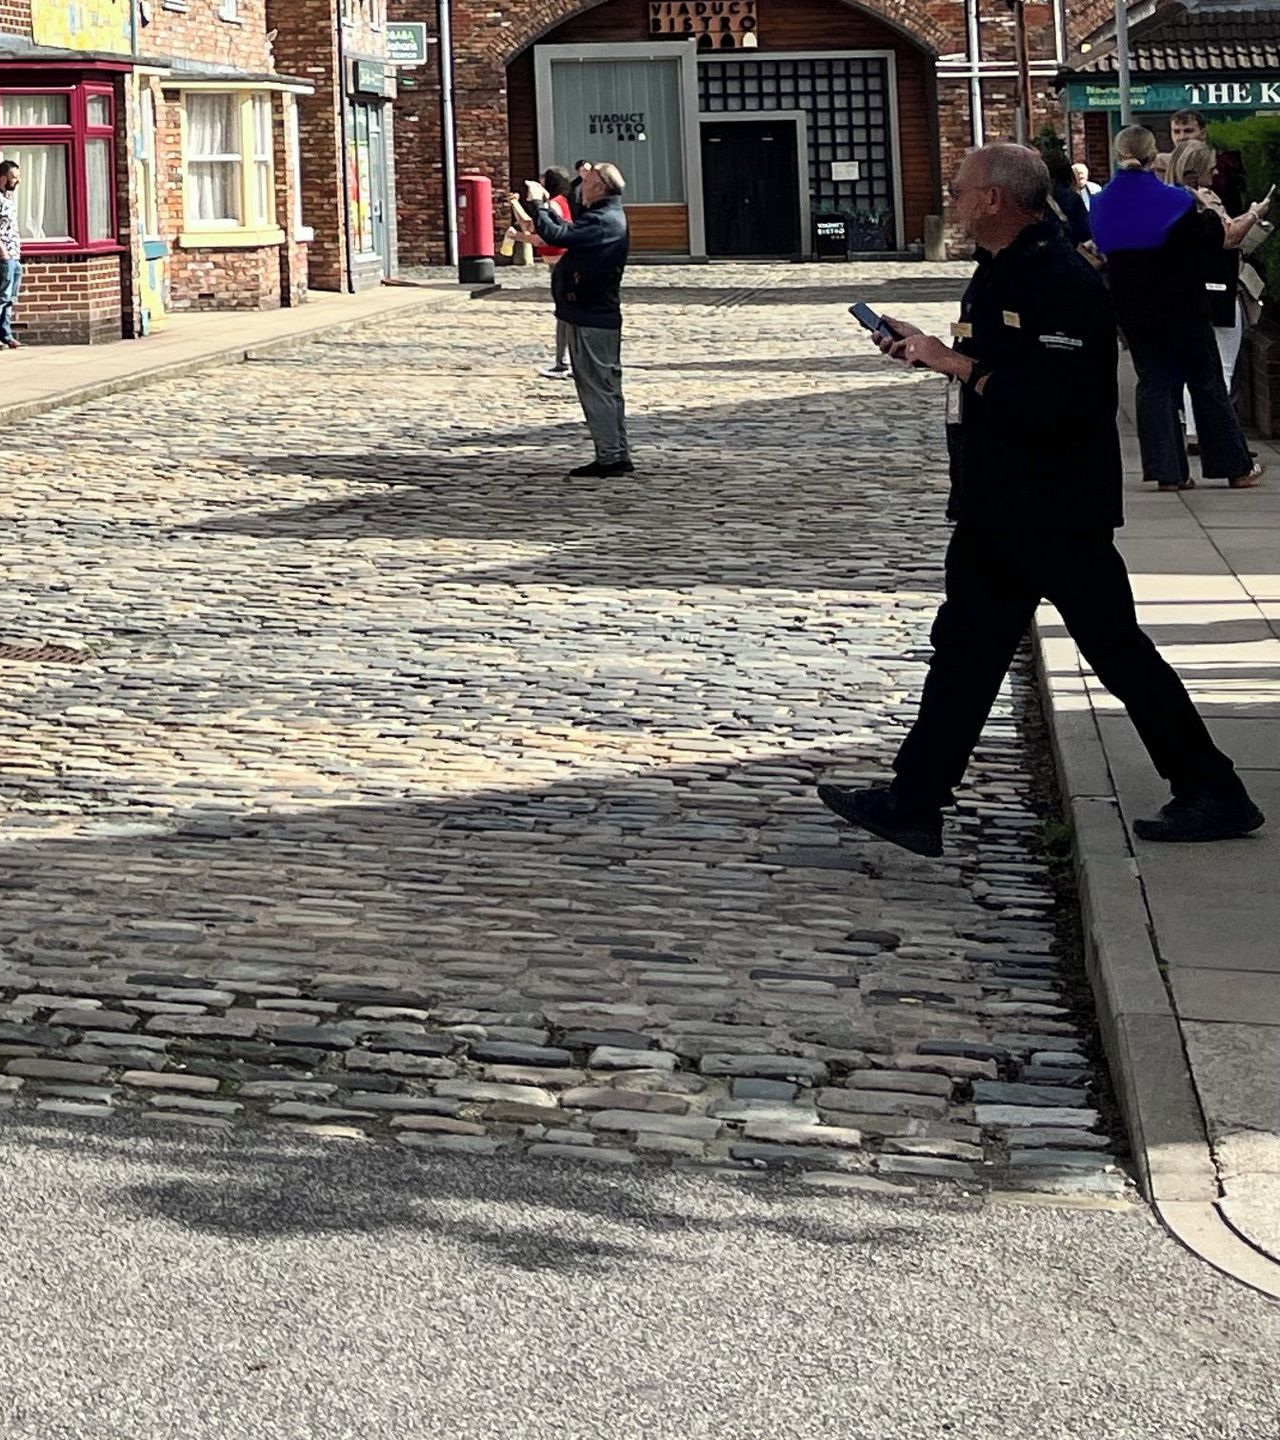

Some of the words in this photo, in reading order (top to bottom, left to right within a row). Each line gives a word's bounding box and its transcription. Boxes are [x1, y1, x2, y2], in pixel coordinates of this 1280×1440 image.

[651, 1, 755, 16] VIADUCT
[651, 16, 756, 32] BISTRO
[1185, 83, 1252, 105] THE
[589, 113, 644, 123] VIADUCT
[589, 123, 645, 134] BISTRO
